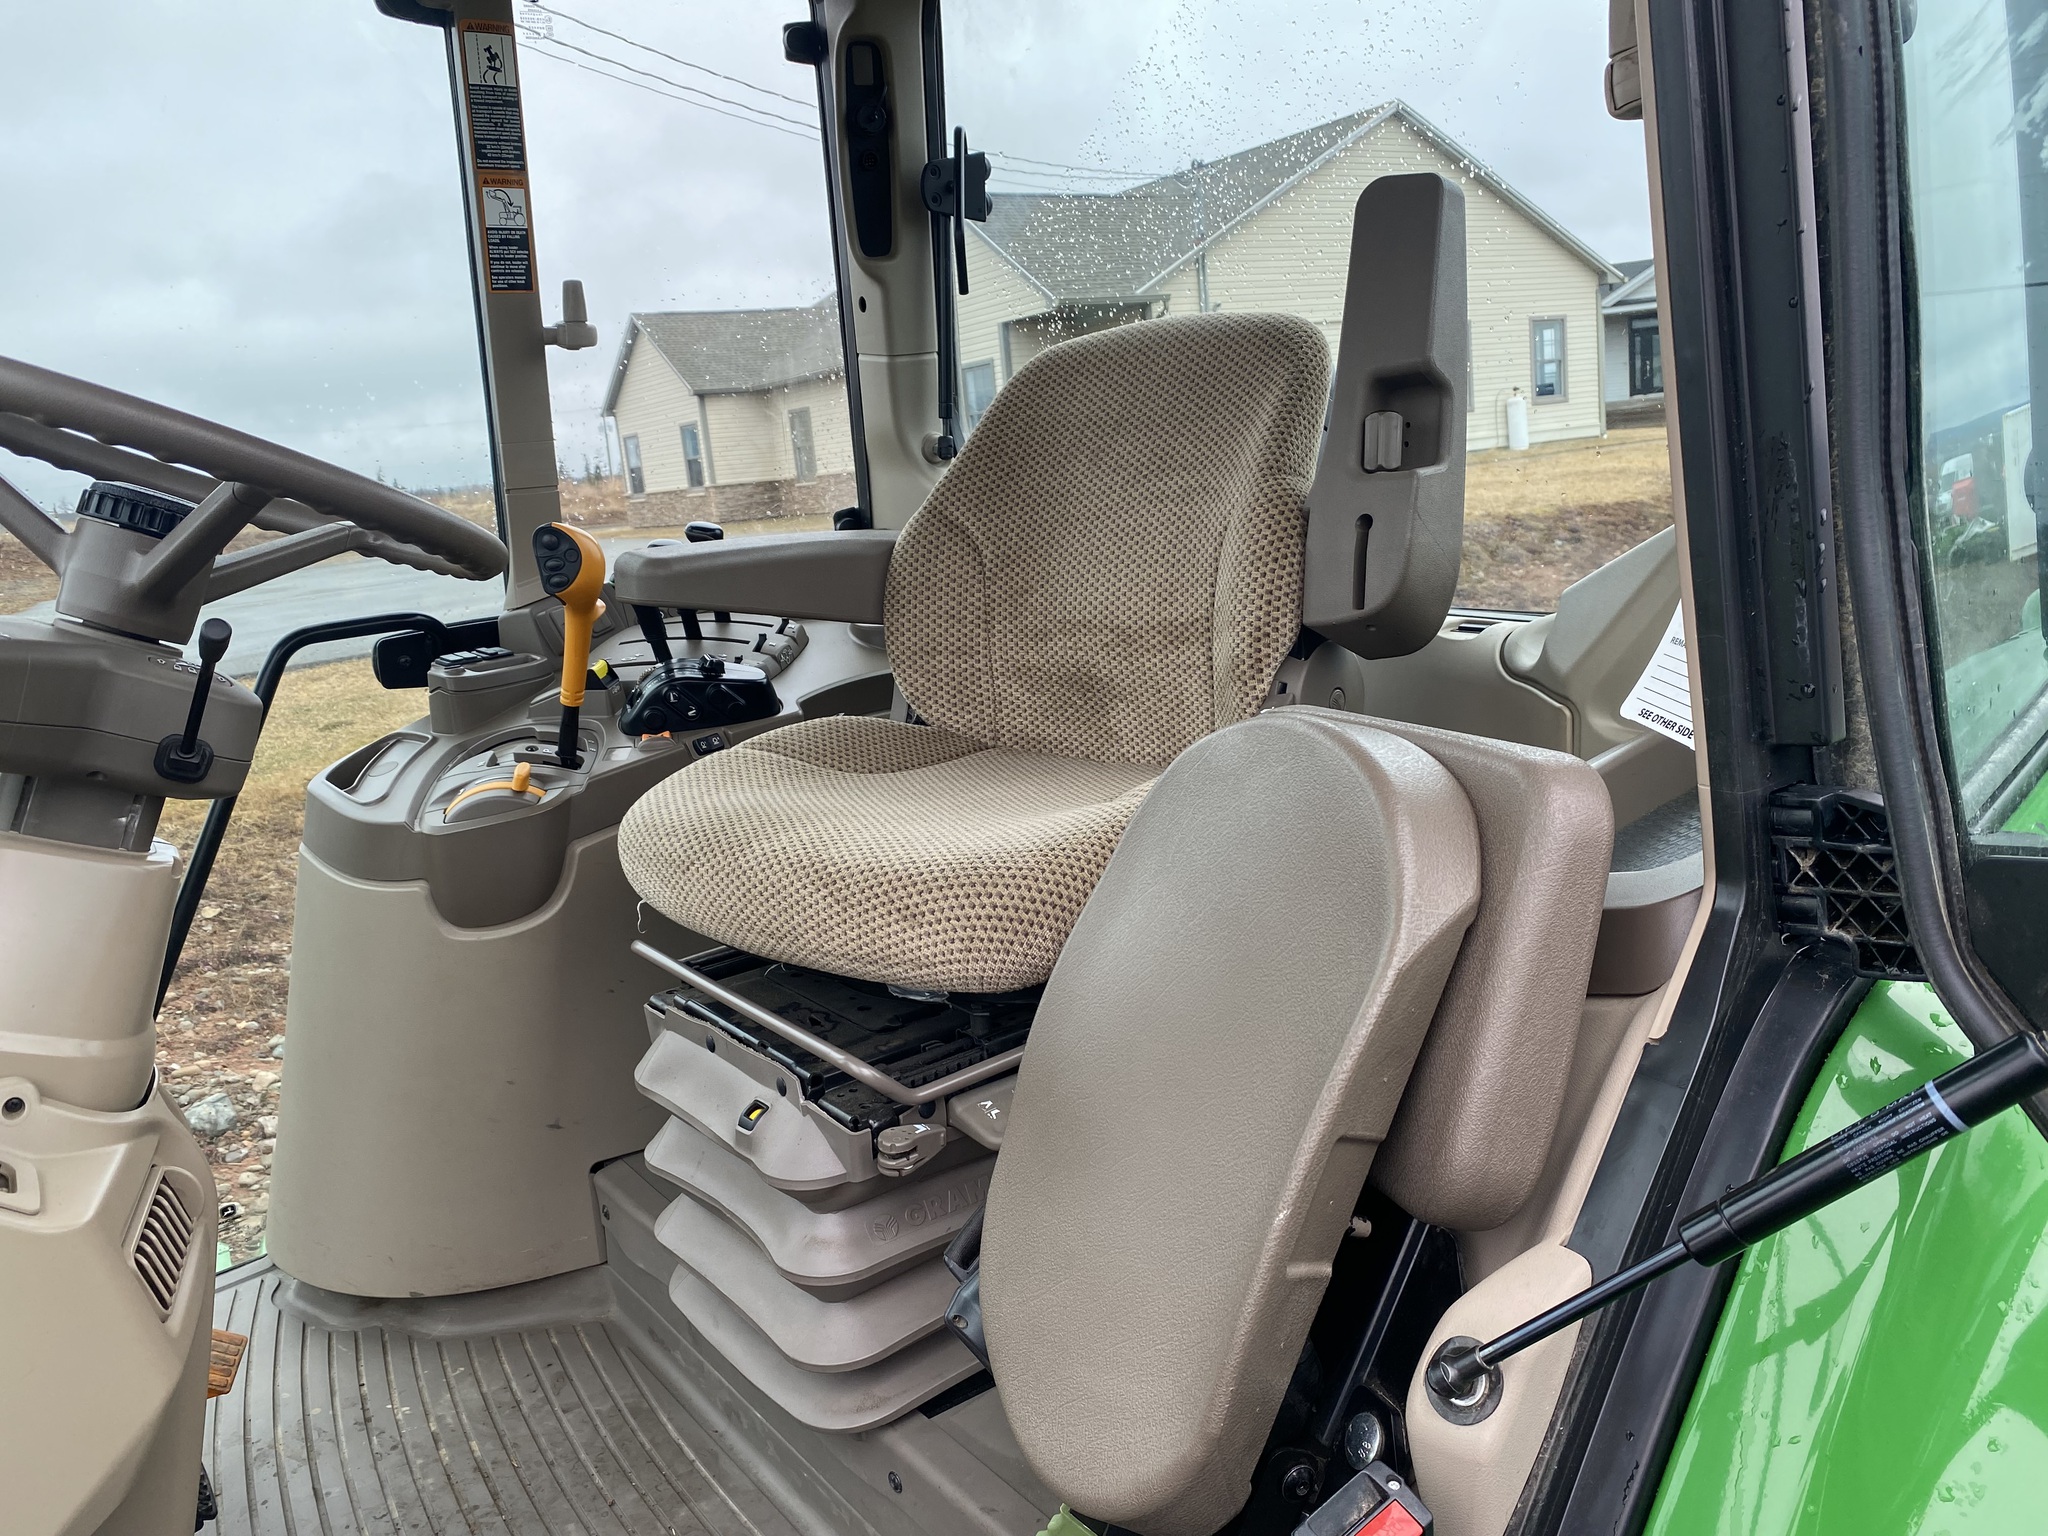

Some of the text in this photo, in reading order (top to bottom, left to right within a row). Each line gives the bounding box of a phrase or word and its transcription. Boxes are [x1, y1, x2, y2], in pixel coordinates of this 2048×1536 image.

[474, 22, 510, 33] WARNING
[489, 177, 524, 186] WARNING
[1638, 708, 1694, 740] SEE OTHER SIDE
